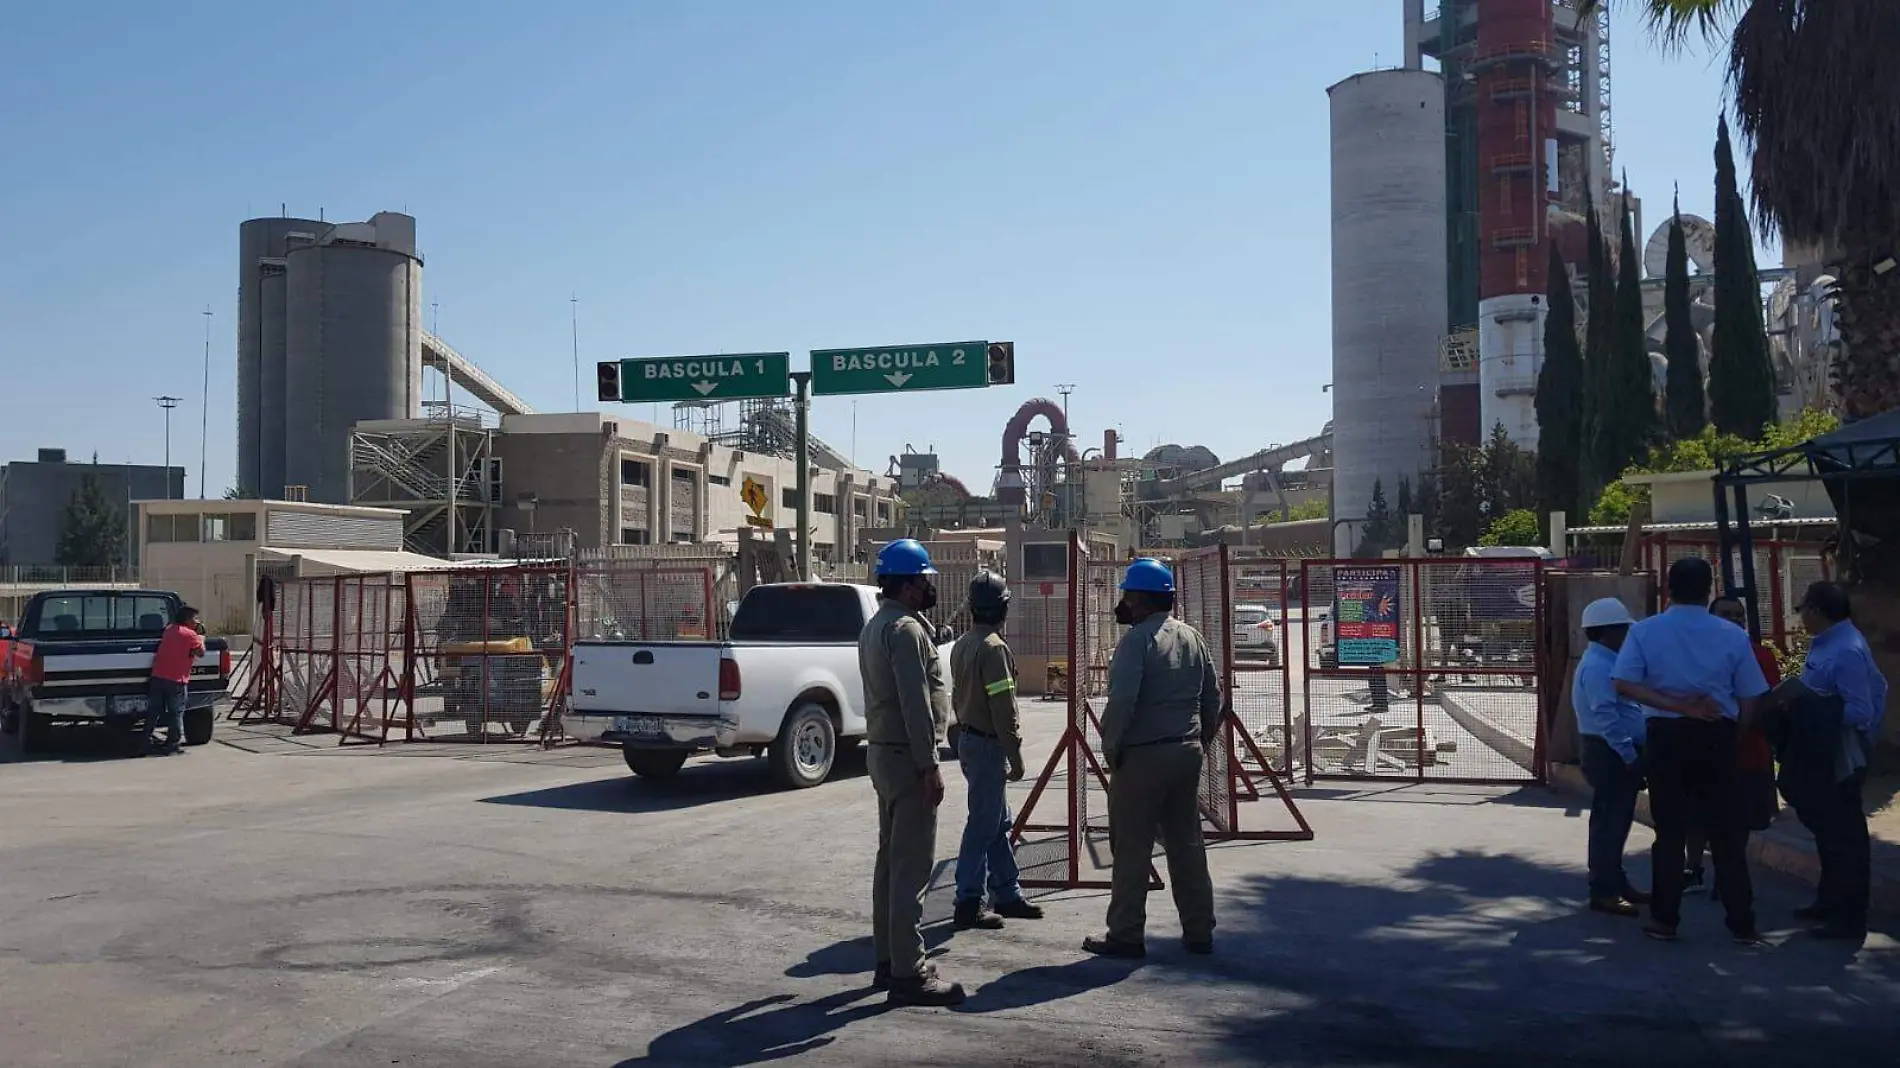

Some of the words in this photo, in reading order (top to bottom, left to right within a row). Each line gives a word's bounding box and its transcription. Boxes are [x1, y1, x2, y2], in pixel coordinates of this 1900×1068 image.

[644, 360, 744, 379] BASCULA
[755, 359, 764, 374] 1
[833, 350, 939, 371] BASCULA
[952, 348, 965, 365] 2
